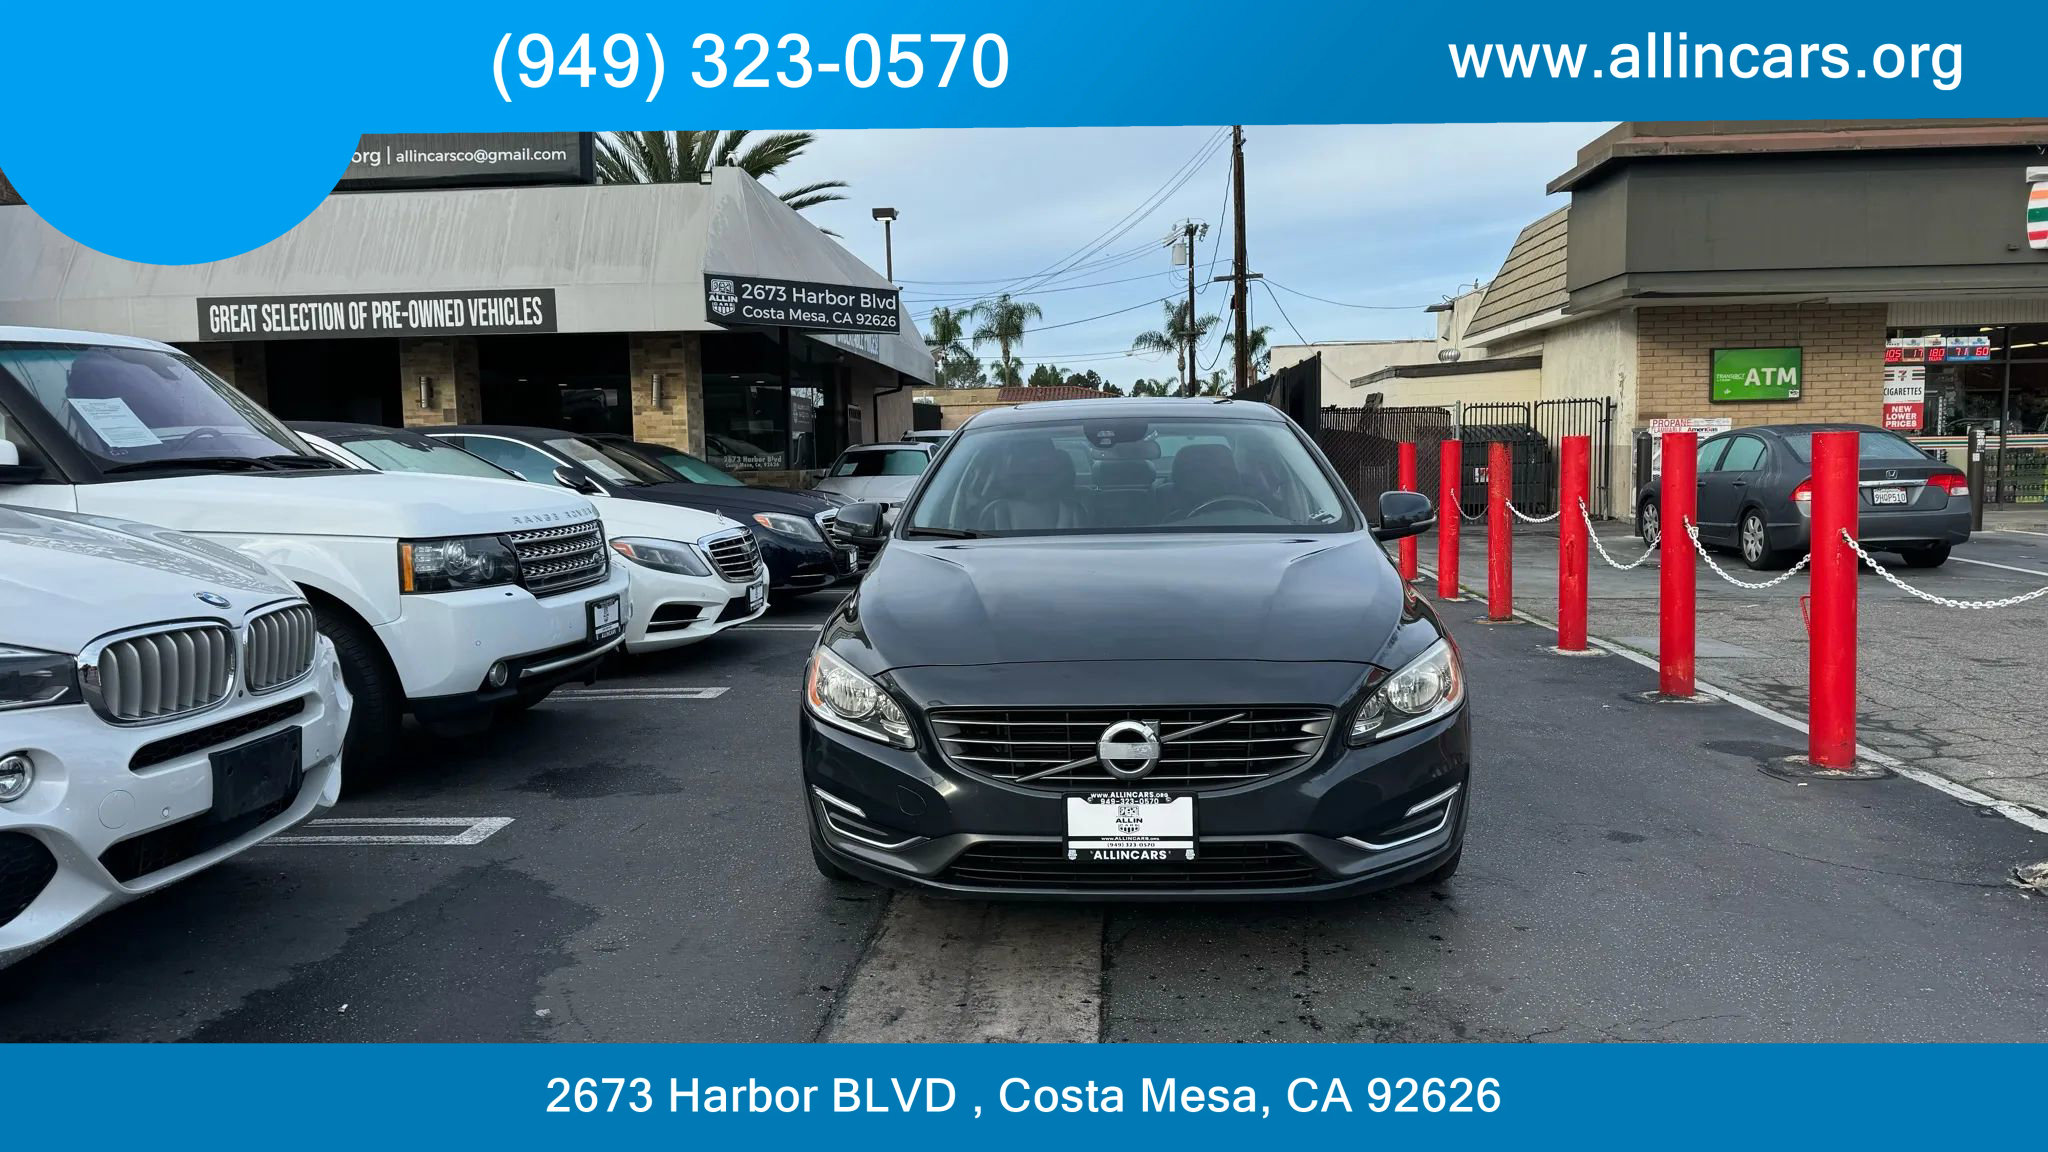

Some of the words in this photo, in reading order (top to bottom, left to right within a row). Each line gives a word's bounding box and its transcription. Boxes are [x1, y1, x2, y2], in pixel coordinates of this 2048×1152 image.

[396, 148, 567, 164] allincarsco@gmail.com
[708, 294, 738, 303] ALLIN
[742, 283, 787, 302] 2673
[792, 288, 856, 307] Harbor
[860, 293, 897, 310] Blvd
[209, 300, 257, 334] GREAT
[262, 298, 345, 332] SELECTION
[348, 300, 369, 330] OF
[371, 297, 466, 329] PRE-OWNED
[467, 296, 544, 327] VEHICLES
[742, 306, 785, 320] Costa
[789, 308, 830, 324] Mesa,
[832, 311, 854, 325] CA
[856, 313, 897, 328] 92626
[1744, 367, 1797, 387] ATM
[1883, 386, 1922, 396] CIGARETTES
[1652, 419, 1694, 428] PROPANE
